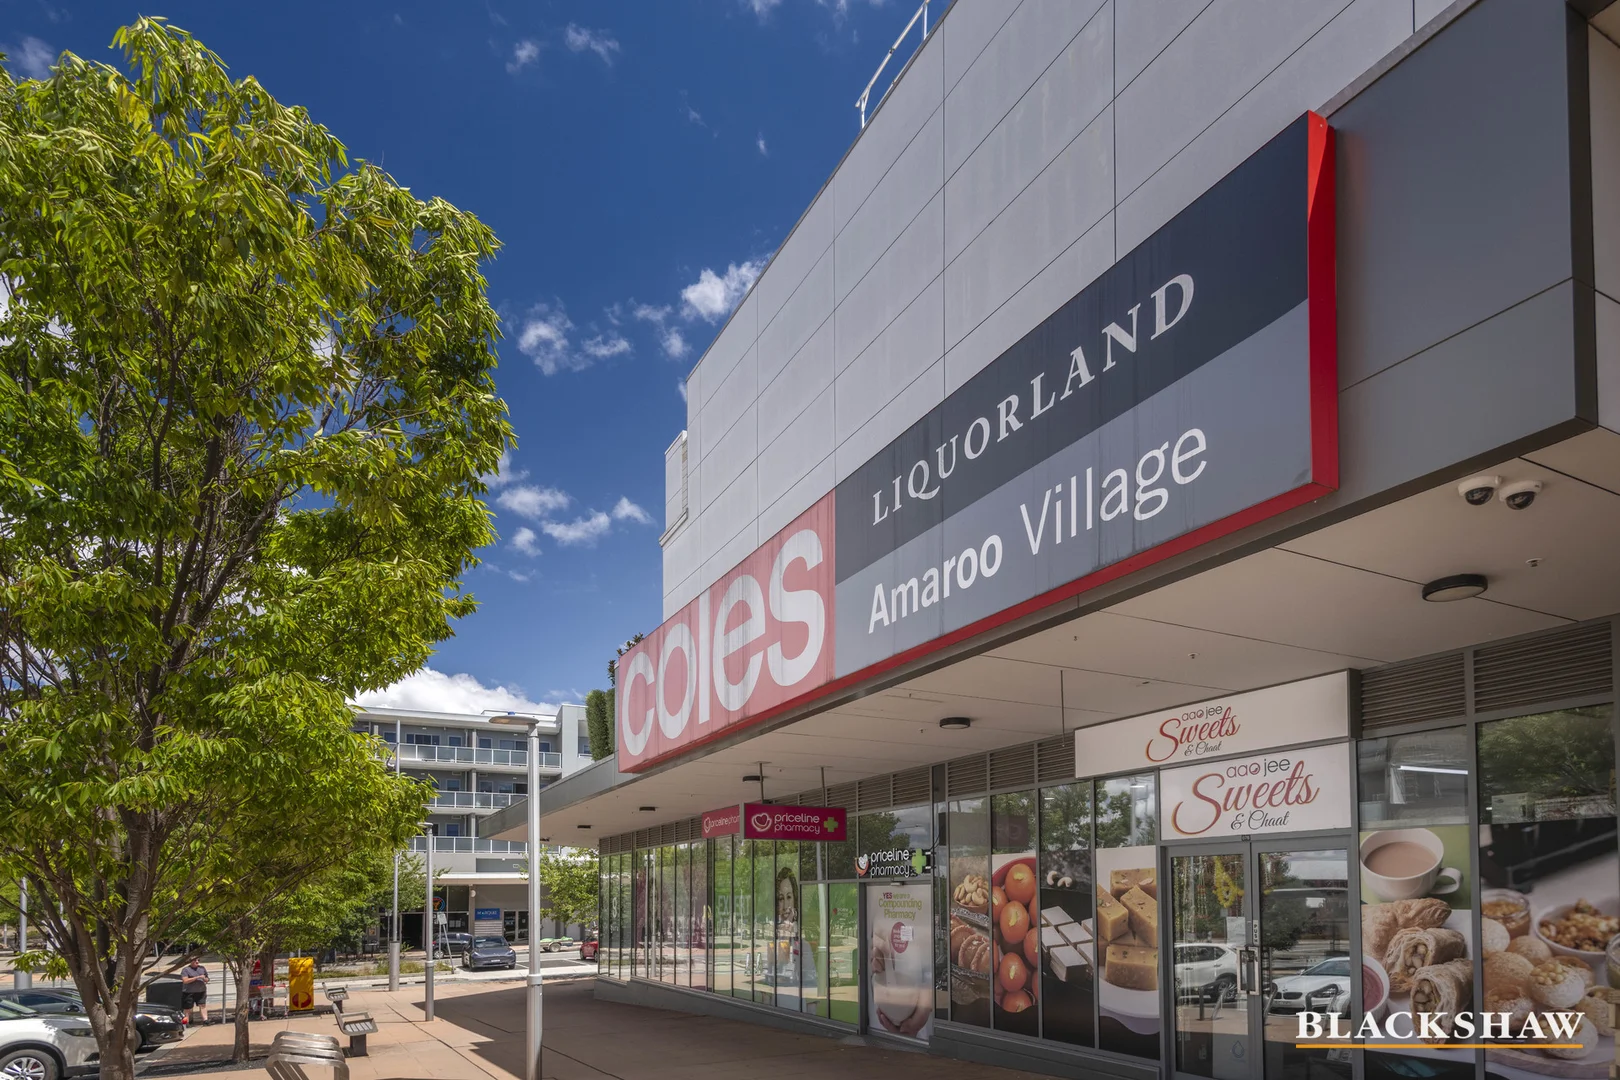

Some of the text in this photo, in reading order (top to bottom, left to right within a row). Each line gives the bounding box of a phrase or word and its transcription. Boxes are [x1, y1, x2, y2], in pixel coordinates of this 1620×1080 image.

[872, 273, 1195, 526] LIQUORLAND
[868, 428, 1207, 634] Amaroo Village
[622, 529, 825, 756] coles
[1145, 706, 1241, 762] Sweets
[1263, 758, 1290, 777] jee
[1171, 760, 1320, 835] Sweets
[774, 812, 820, 824] priceline
[1230, 809, 1290, 830] & Chaat
[774, 823, 820, 835] pharmacy
[870, 848, 910, 865] priceline
[870, 865, 910, 878] pharmacy
[879, 899, 923, 910] Compounding
[884, 909, 917, 920] Pharmacy
